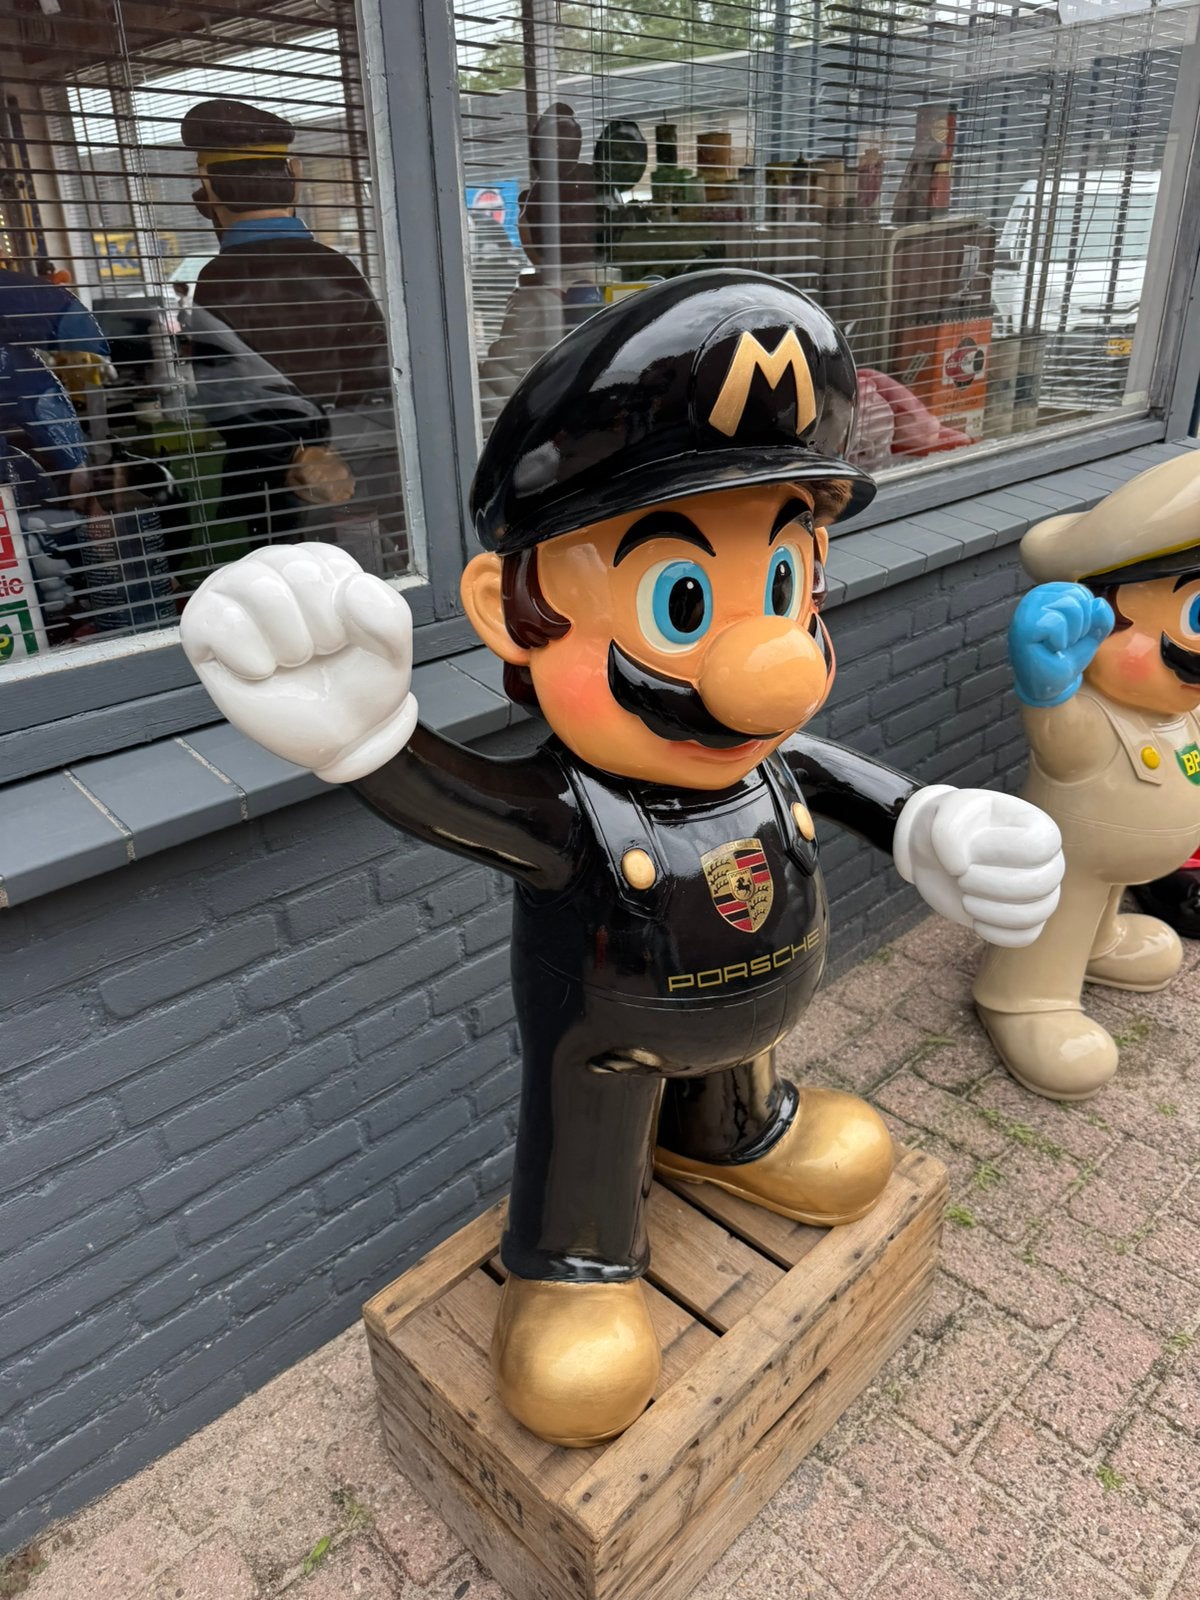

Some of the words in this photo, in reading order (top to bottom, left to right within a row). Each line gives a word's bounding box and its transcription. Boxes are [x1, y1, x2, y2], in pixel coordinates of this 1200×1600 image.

[708, 329, 816, 437] M
[1181, 750, 1200, 776] BP
[668, 928, 820, 993] PORSCHE
